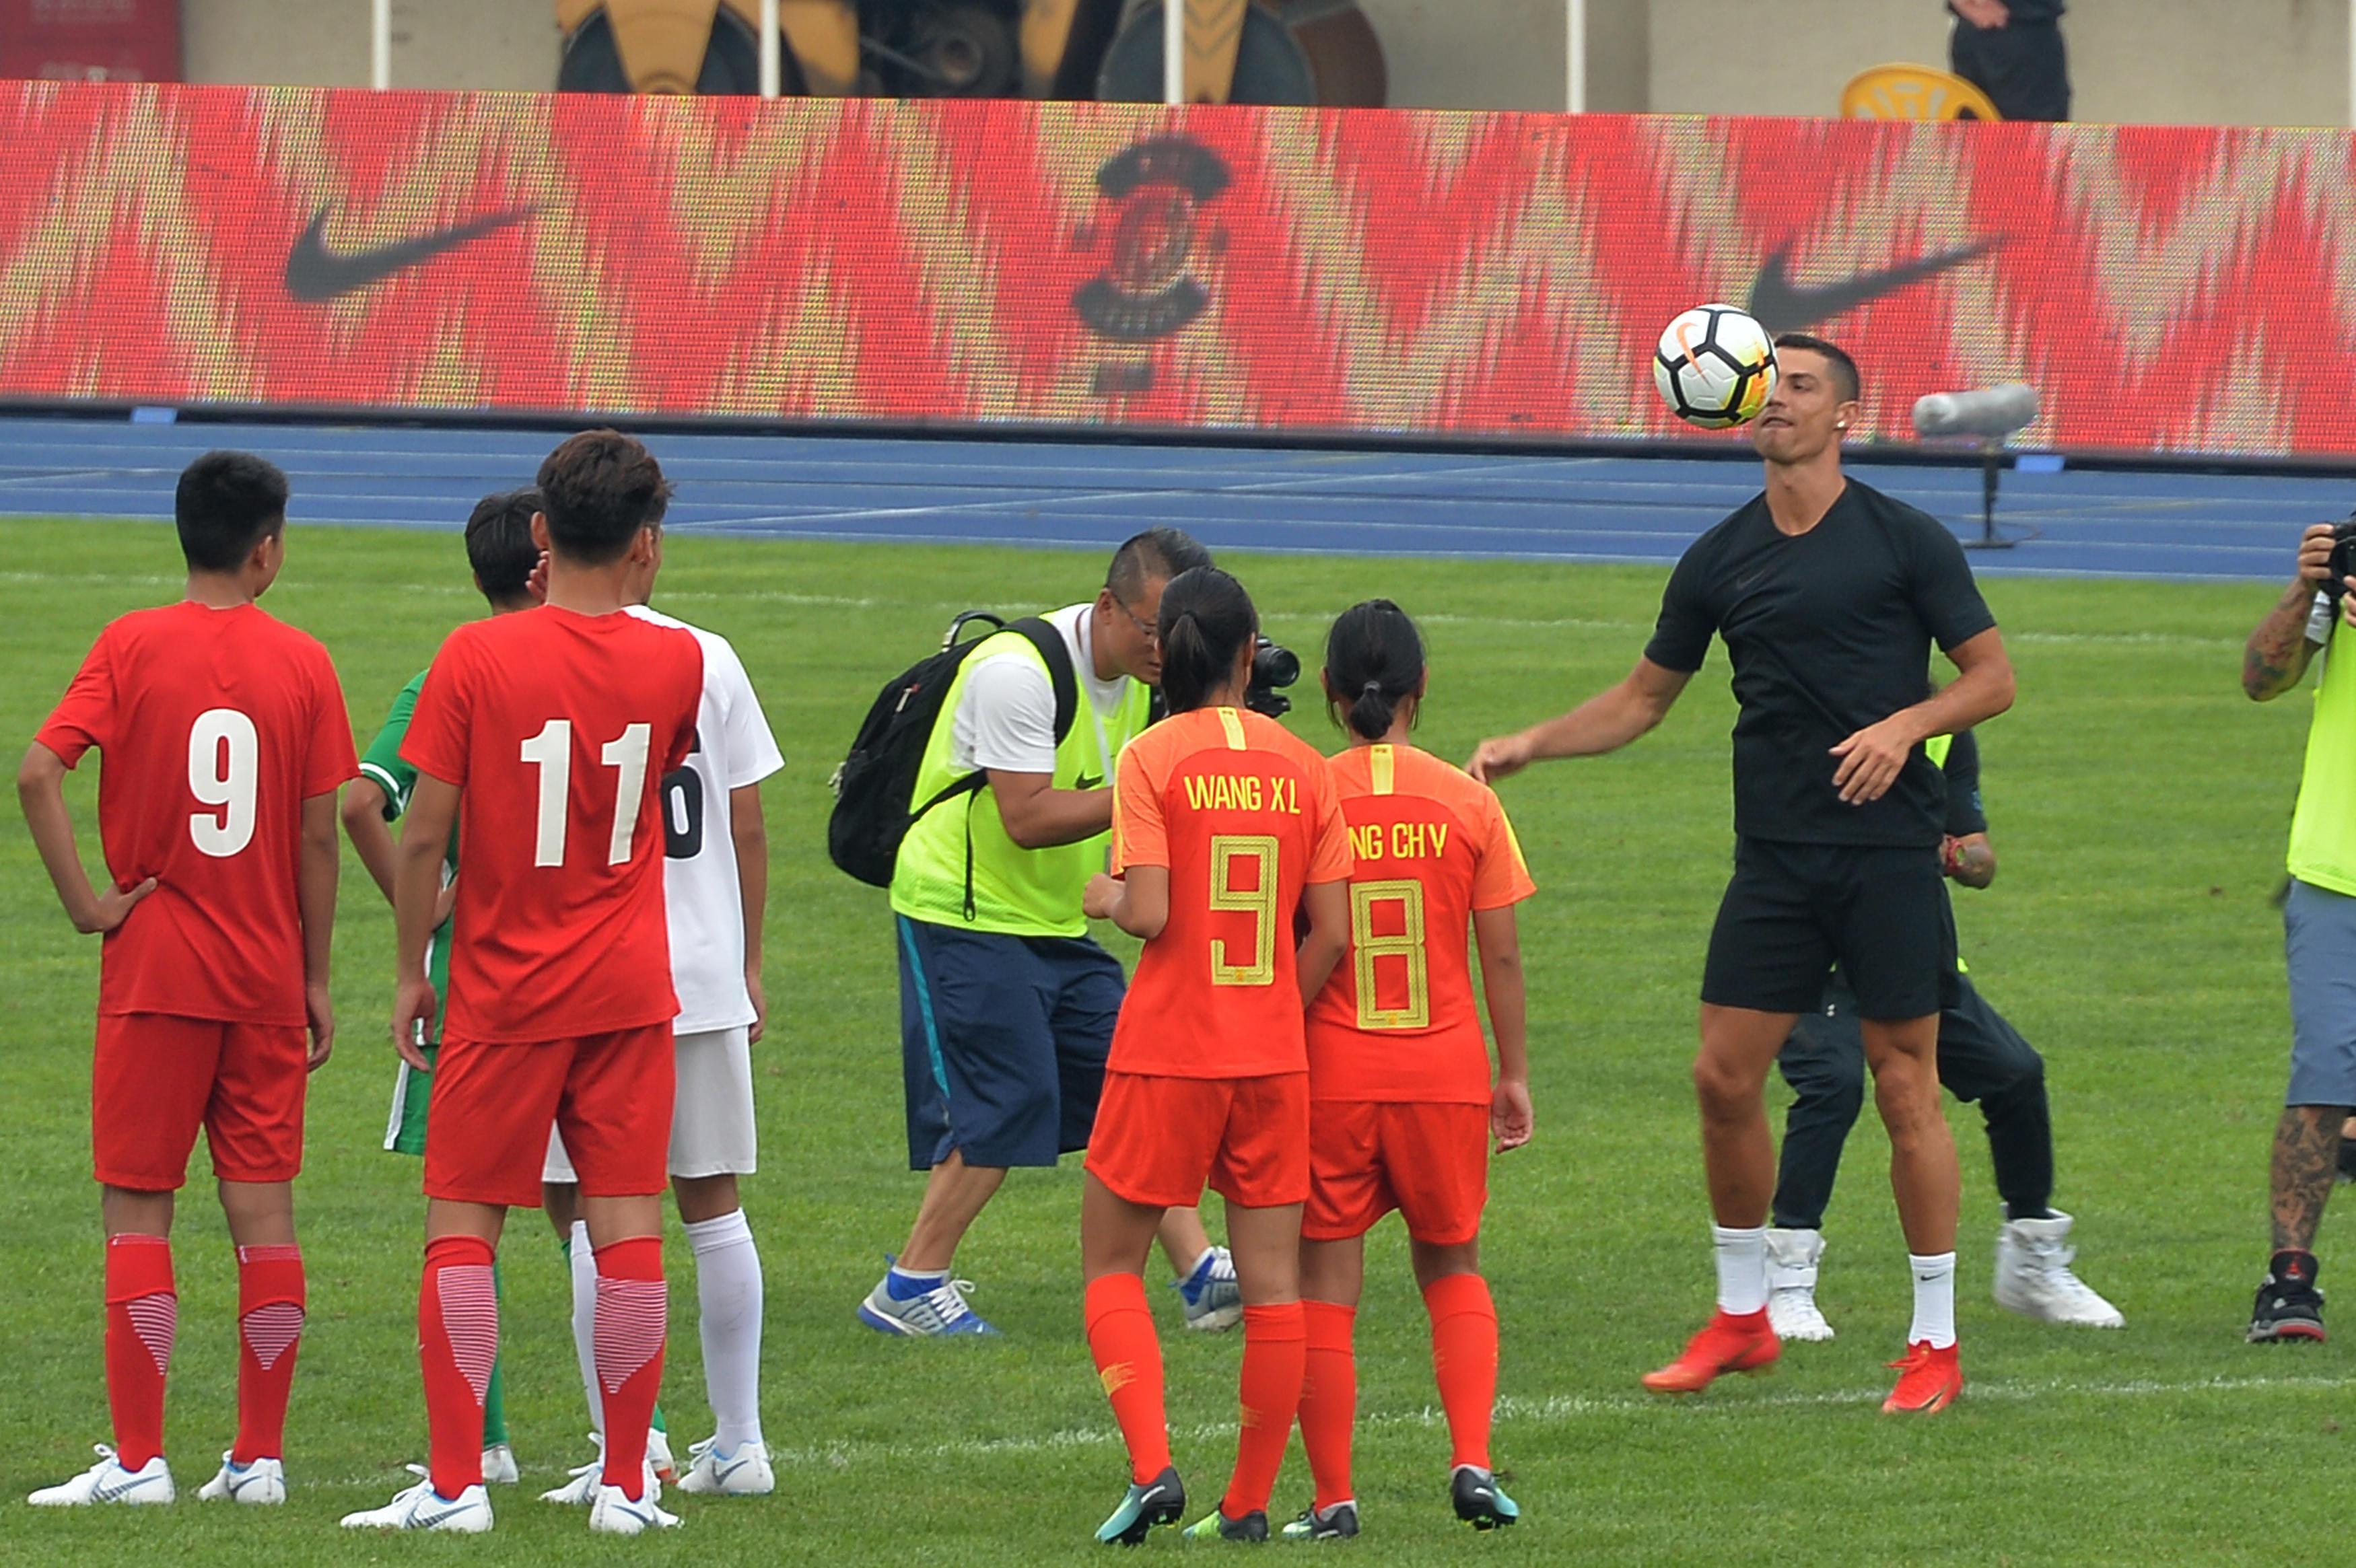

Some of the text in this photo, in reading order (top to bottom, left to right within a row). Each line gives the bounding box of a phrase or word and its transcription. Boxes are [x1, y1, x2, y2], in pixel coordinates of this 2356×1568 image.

[189, 709, 258, 857] 9
[520, 719, 651, 867] 11
[1184, 775, 1301, 815] WANG XL
[1347, 822, 1449, 861] NG CHY
[1209, 834, 1279, 987] 9
[1349, 879, 1430, 1029] 8
